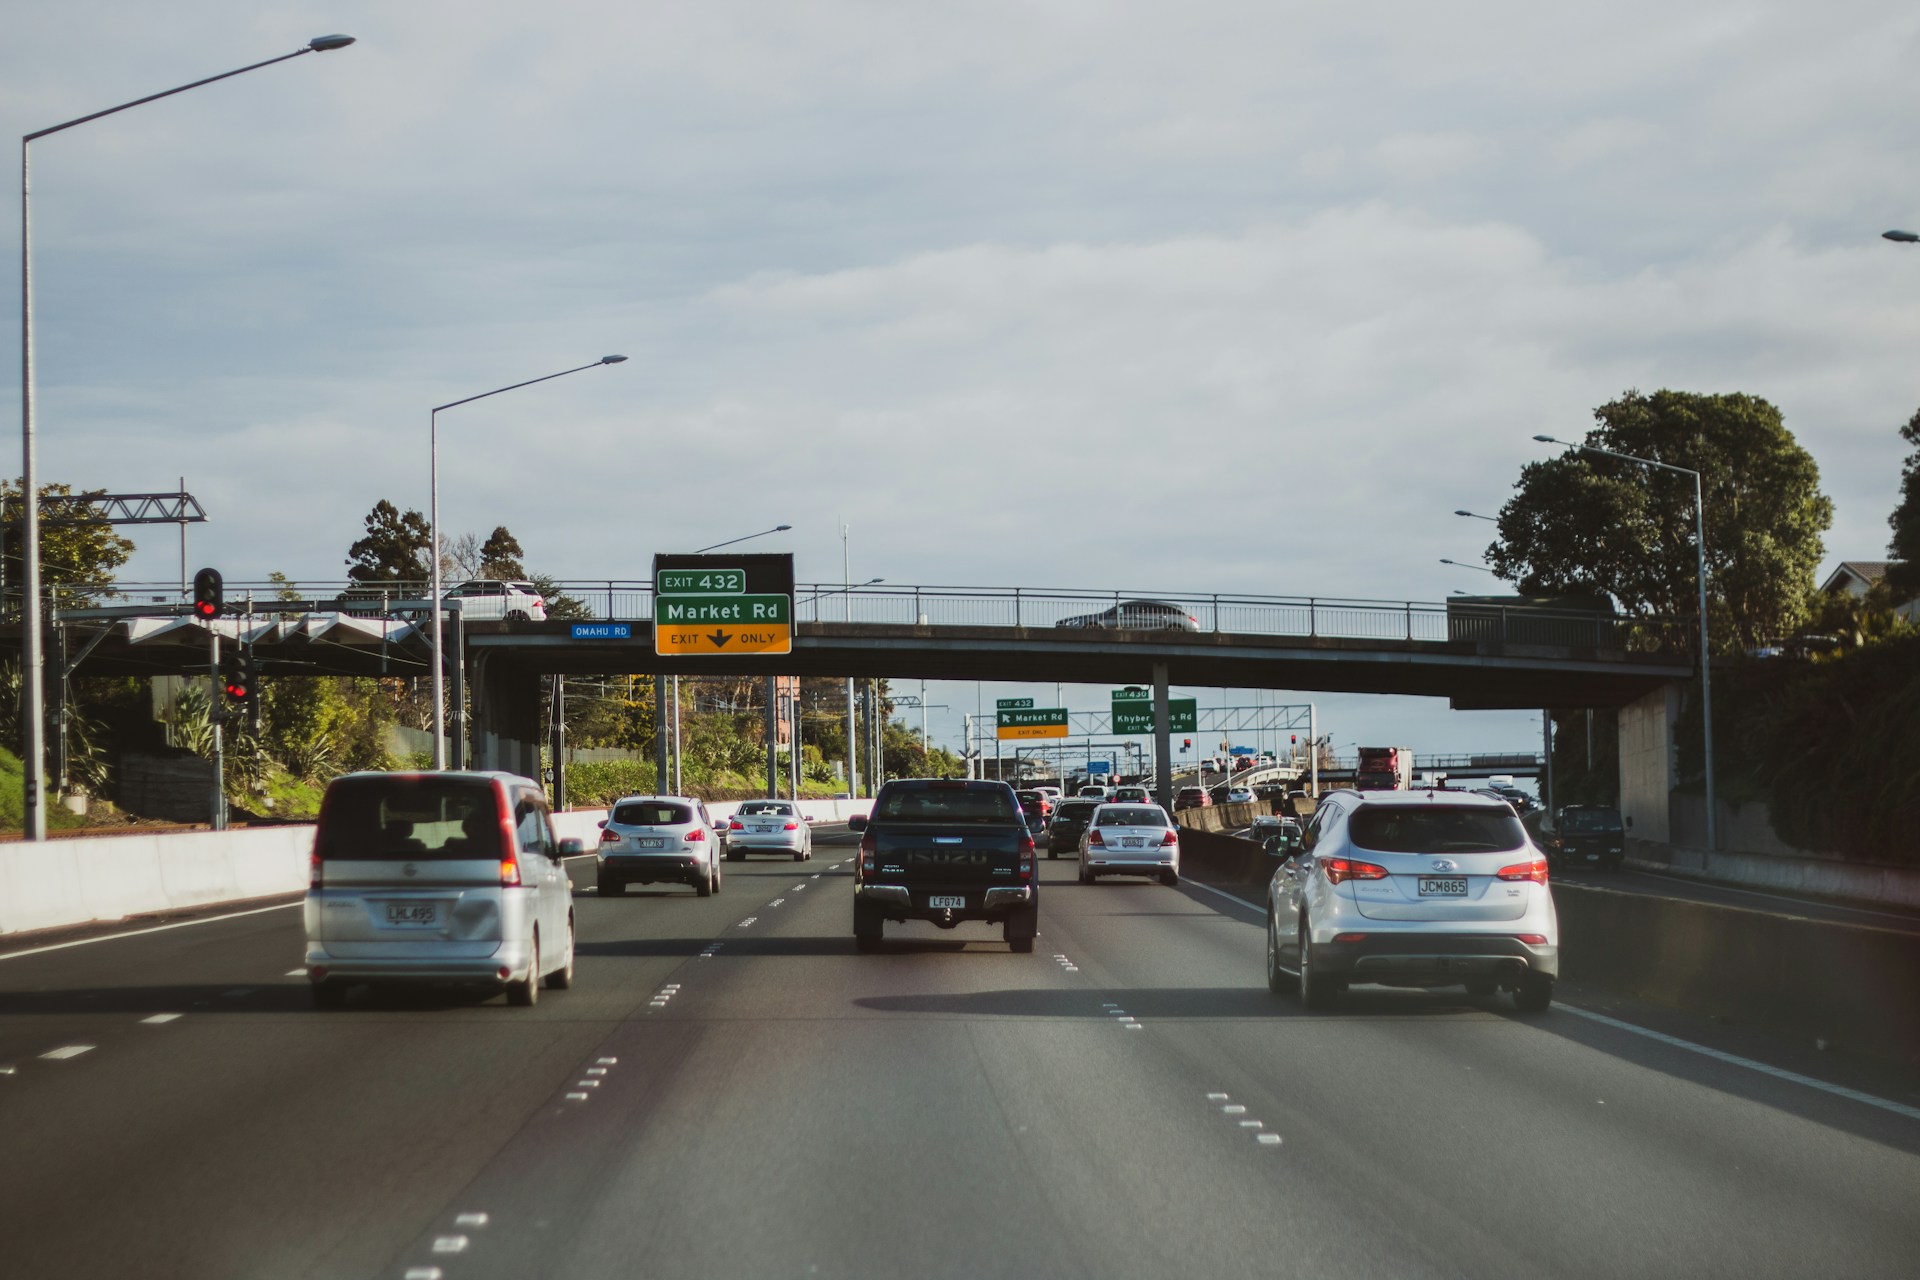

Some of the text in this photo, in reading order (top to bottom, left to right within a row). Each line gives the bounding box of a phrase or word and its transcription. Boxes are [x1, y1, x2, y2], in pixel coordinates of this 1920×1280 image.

[665, 575, 738, 589] EXIT 432
[668, 603, 778, 619] Market Rd
[576, 627, 627, 636] OMAHU RD
[671, 633, 775, 644] EXIT ONLY
[1016, 714, 1047, 722] Market
[1117, 715, 1150, 724] Khyber
[907, 850, 988, 864] ISUZU
[1421, 879, 1466, 893] JCM865
[933, 897, 961, 907] LFG74
